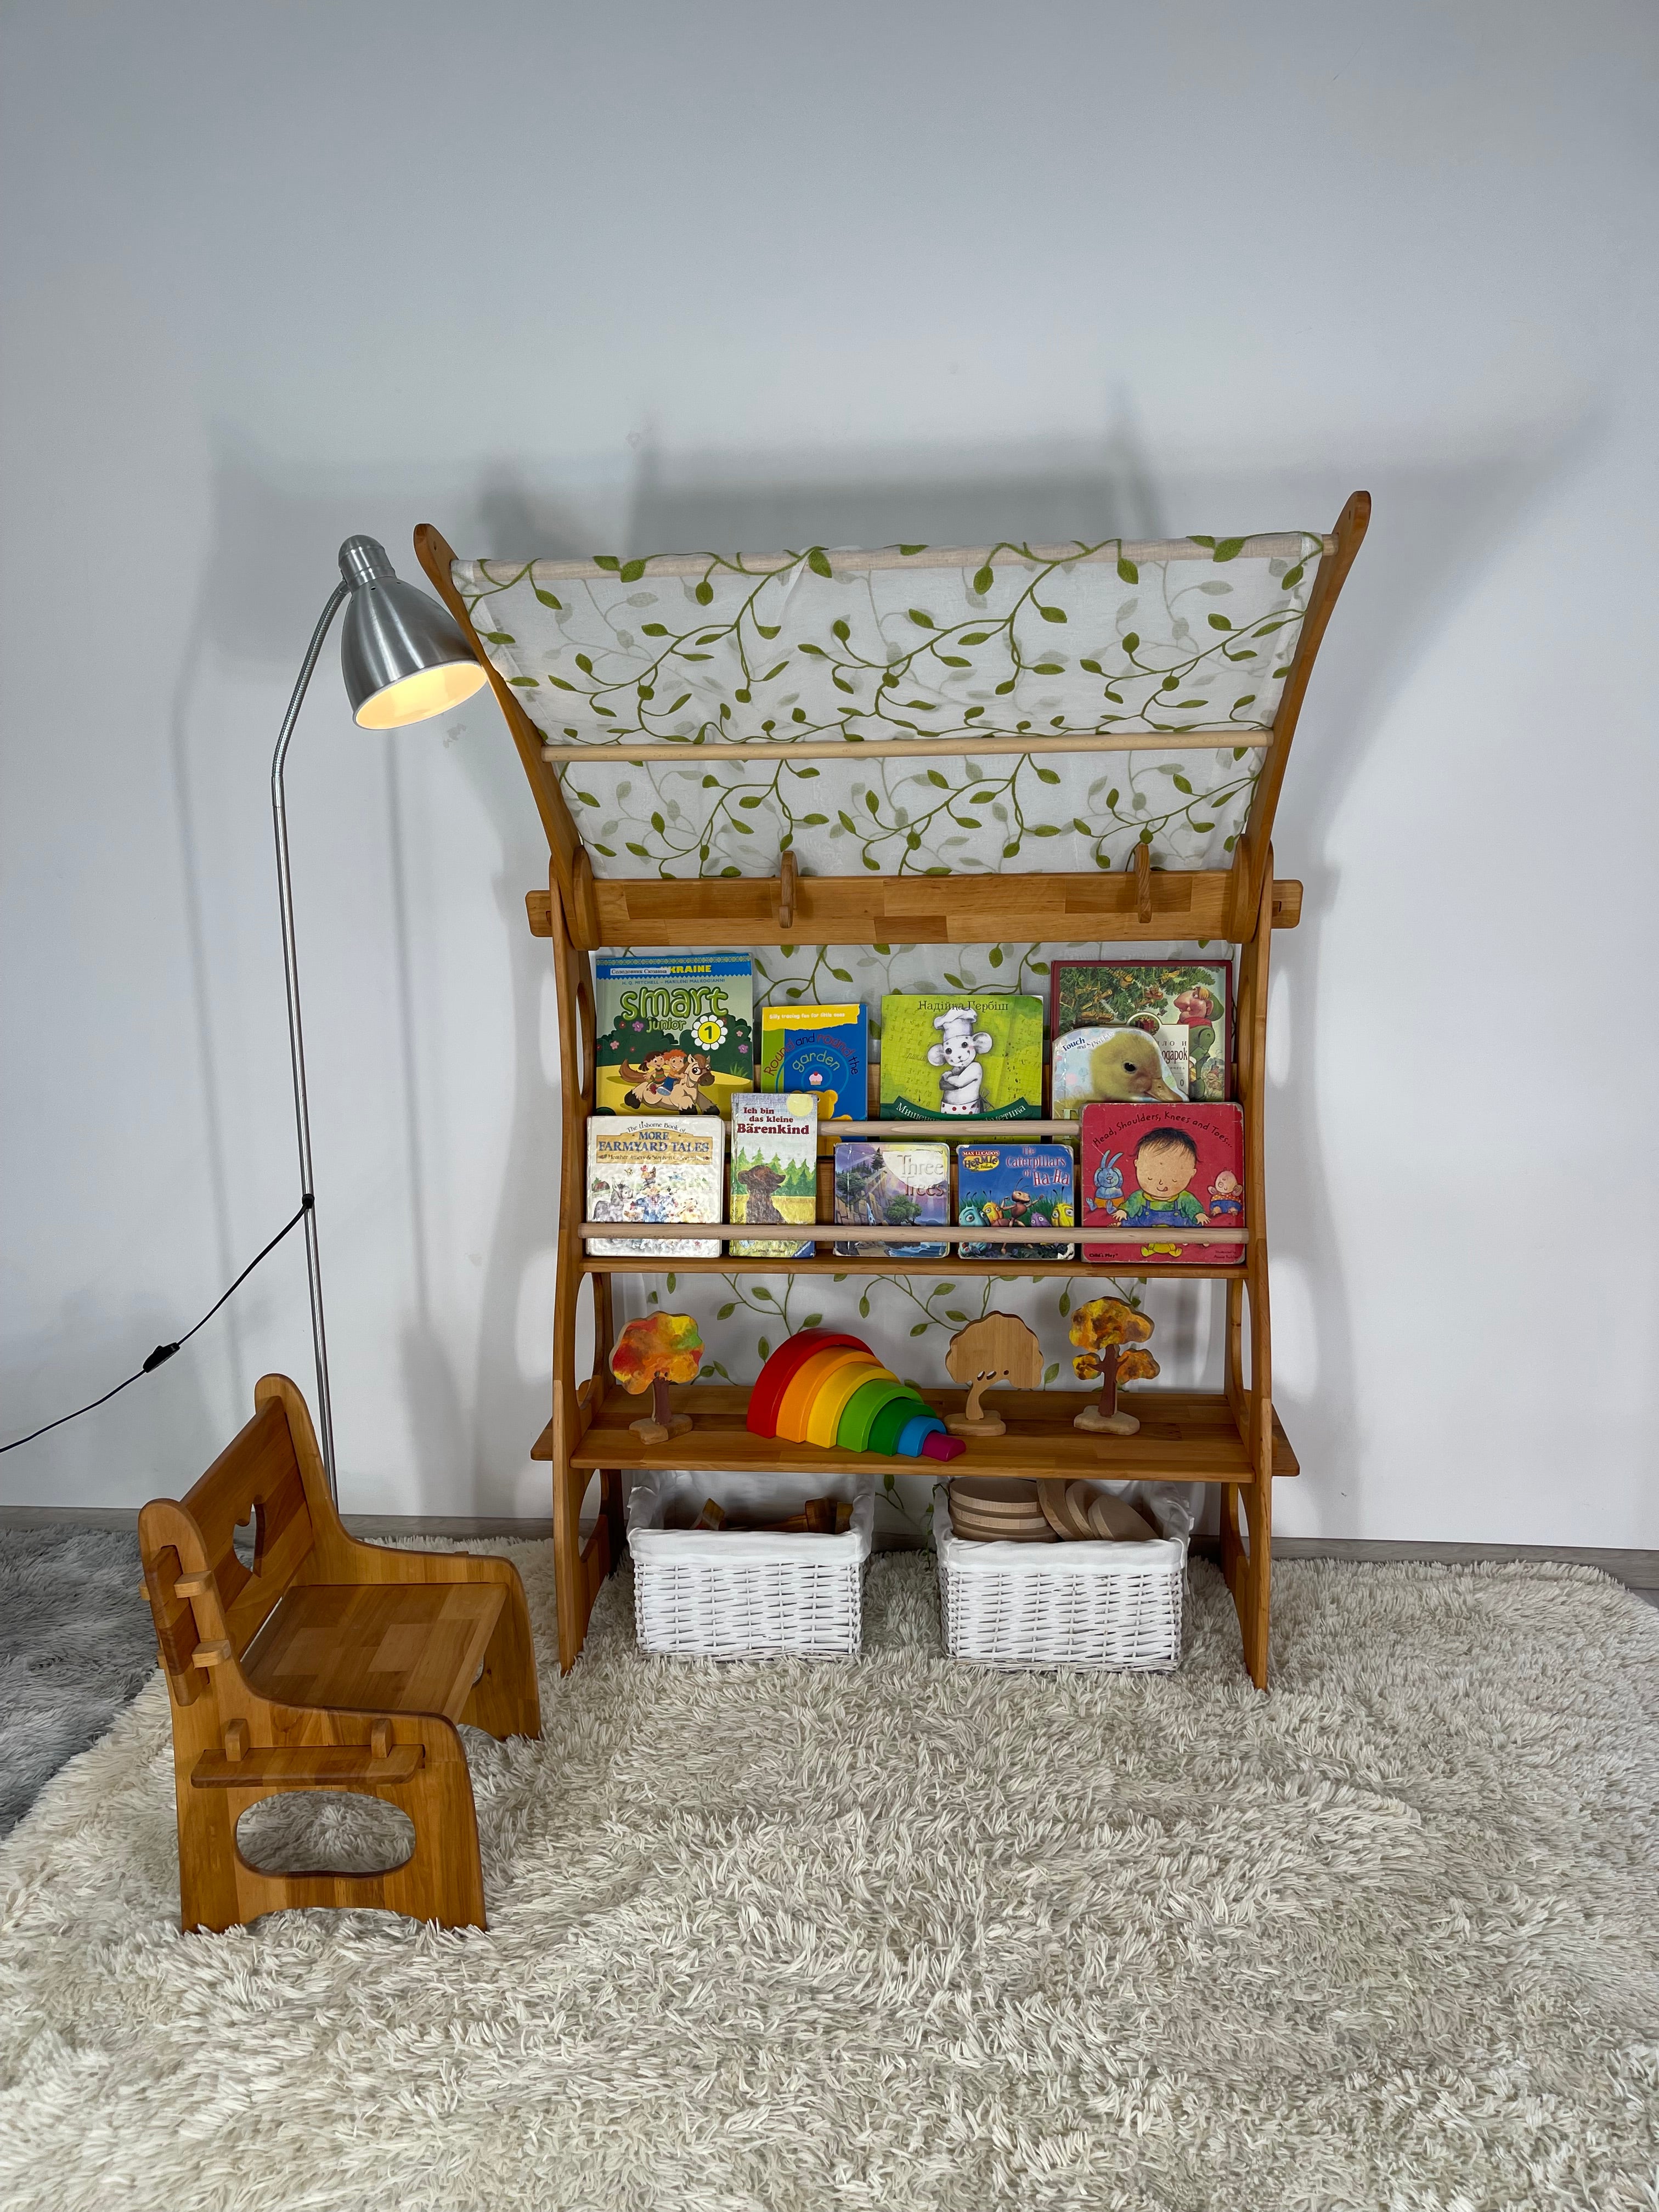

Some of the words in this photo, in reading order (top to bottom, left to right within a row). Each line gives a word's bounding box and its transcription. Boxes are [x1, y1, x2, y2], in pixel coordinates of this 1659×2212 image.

[665, 965, 712, 973] KRAINE
[620, 986, 729, 1020] smart
[917, 1001, 964, 1012] Надійка
[646, 1017, 686, 1033] junior
[704, 1025, 712, 1040] 1
[1062, 1037, 1085, 1052] Touch
[764, 1038, 795, 1076] Round
[795, 1032, 815, 1046] and
[817, 1034, 856, 1058] round
[848, 1056, 860, 1075] the
[792, 1050, 840, 1073] garden
[664, 1122, 679, 1131] Book
[737, 1123, 809, 1135] Bärenkind
[1092, 1127, 1117, 1147] Head,
[1116, 1113, 1161, 1131] Shoulders,
[1164, 1111, 1190, 1124] Knees
[1192, 1119, 1210, 1130] and
[638, 1131, 669, 1140] MORE
[598, 1141, 668, 1152] FARMYARD
[671, 1142, 709, 1152] TALES
[1023, 1146, 1036, 1155] The
[897, 1154, 944, 1175] Three
[1006, 1155, 1066, 1169] Caterpillars
[1033, 1168, 1070, 1186] Ha-Ha
[901, 1176, 944, 1197] Trees
